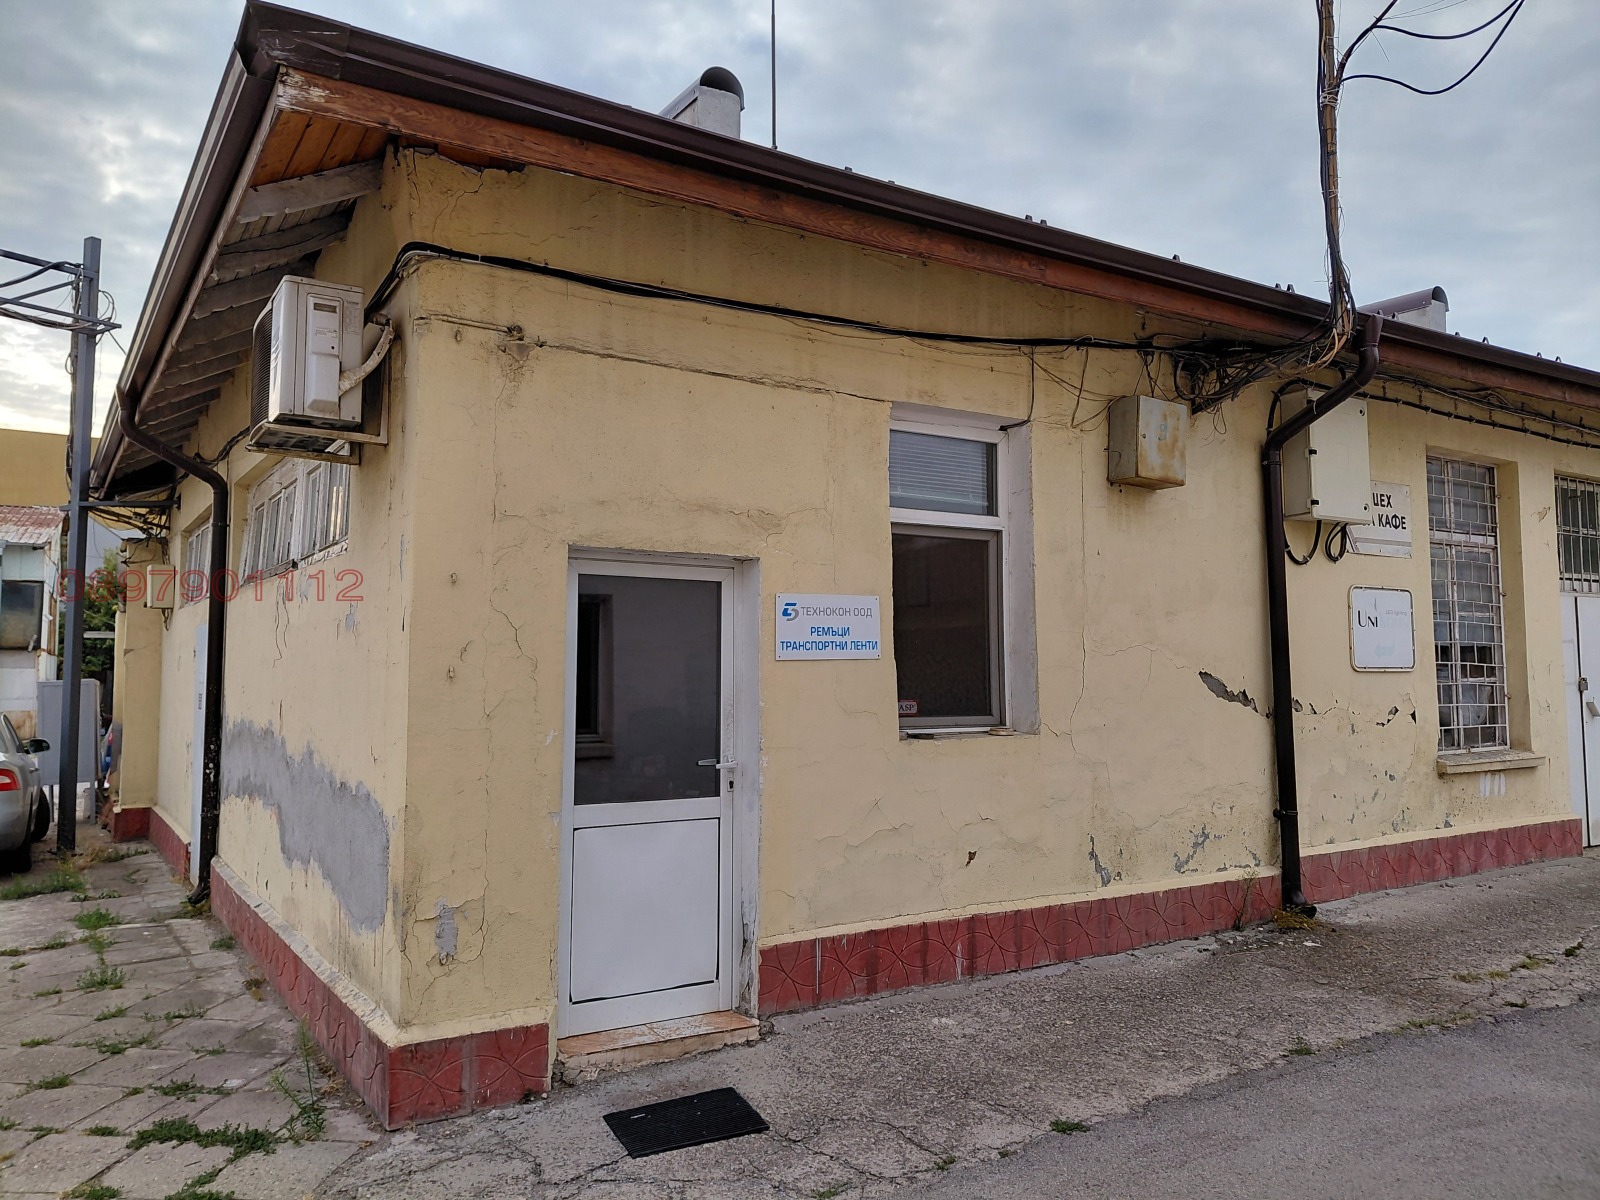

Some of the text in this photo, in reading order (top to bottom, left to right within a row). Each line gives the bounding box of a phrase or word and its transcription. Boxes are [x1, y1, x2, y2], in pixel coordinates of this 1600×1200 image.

[1372, 492, 1393, 509] ЦЕХ
[1377, 513, 1407, 530] КАФЕ
[801, 606, 873, 618] ТЕХНОКОН ООД
[810, 626, 851, 638] РЕМЪЦИ
[780, 640, 878, 651] ТРАНСПОРТНИ ЛЕНТИ
